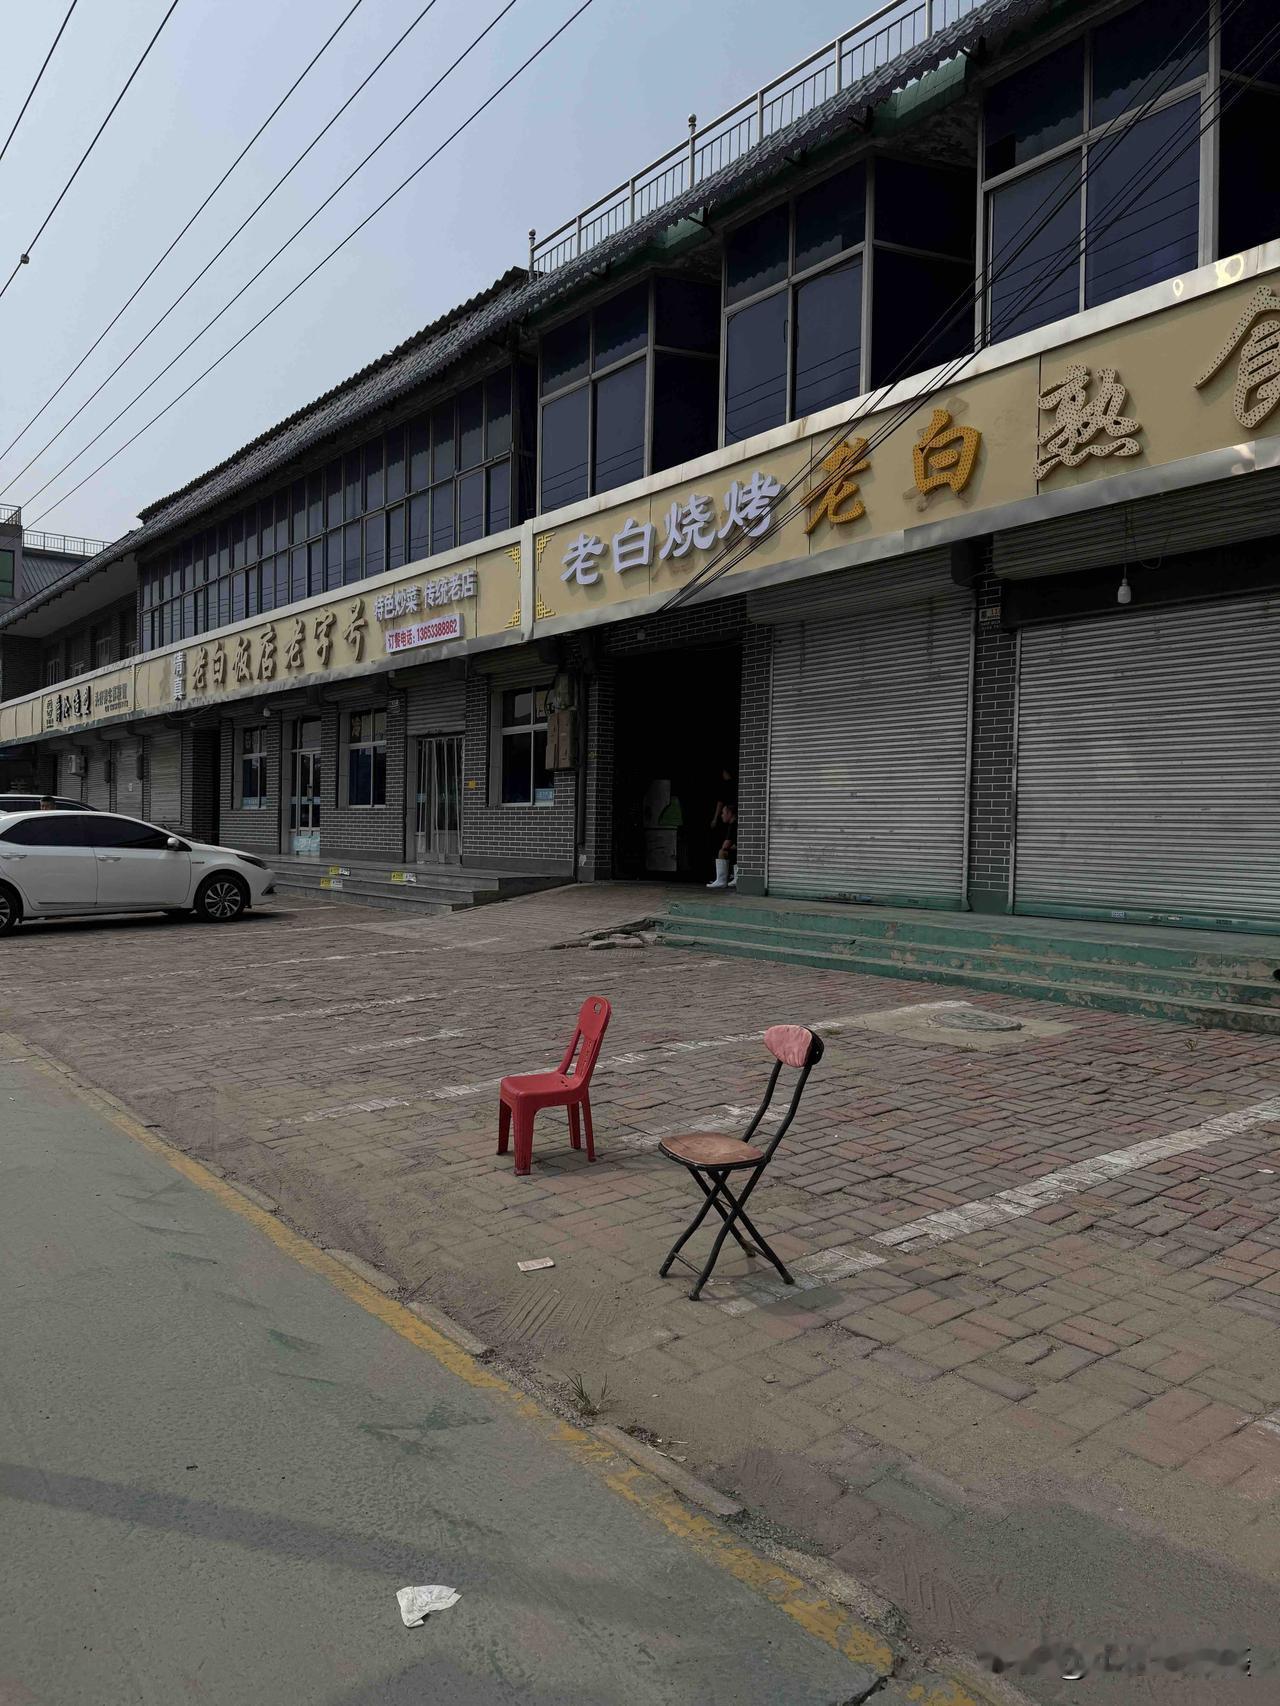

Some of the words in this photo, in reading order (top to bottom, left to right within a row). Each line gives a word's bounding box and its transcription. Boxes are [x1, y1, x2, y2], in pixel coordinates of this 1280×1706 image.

[560, 471, 783, 585] 老白烧烤
[374, 585, 421, 622] 特色炒菜
[424, 568, 478, 609] 传统老店
[192, 598, 367, 690] 老白饭店老字号
